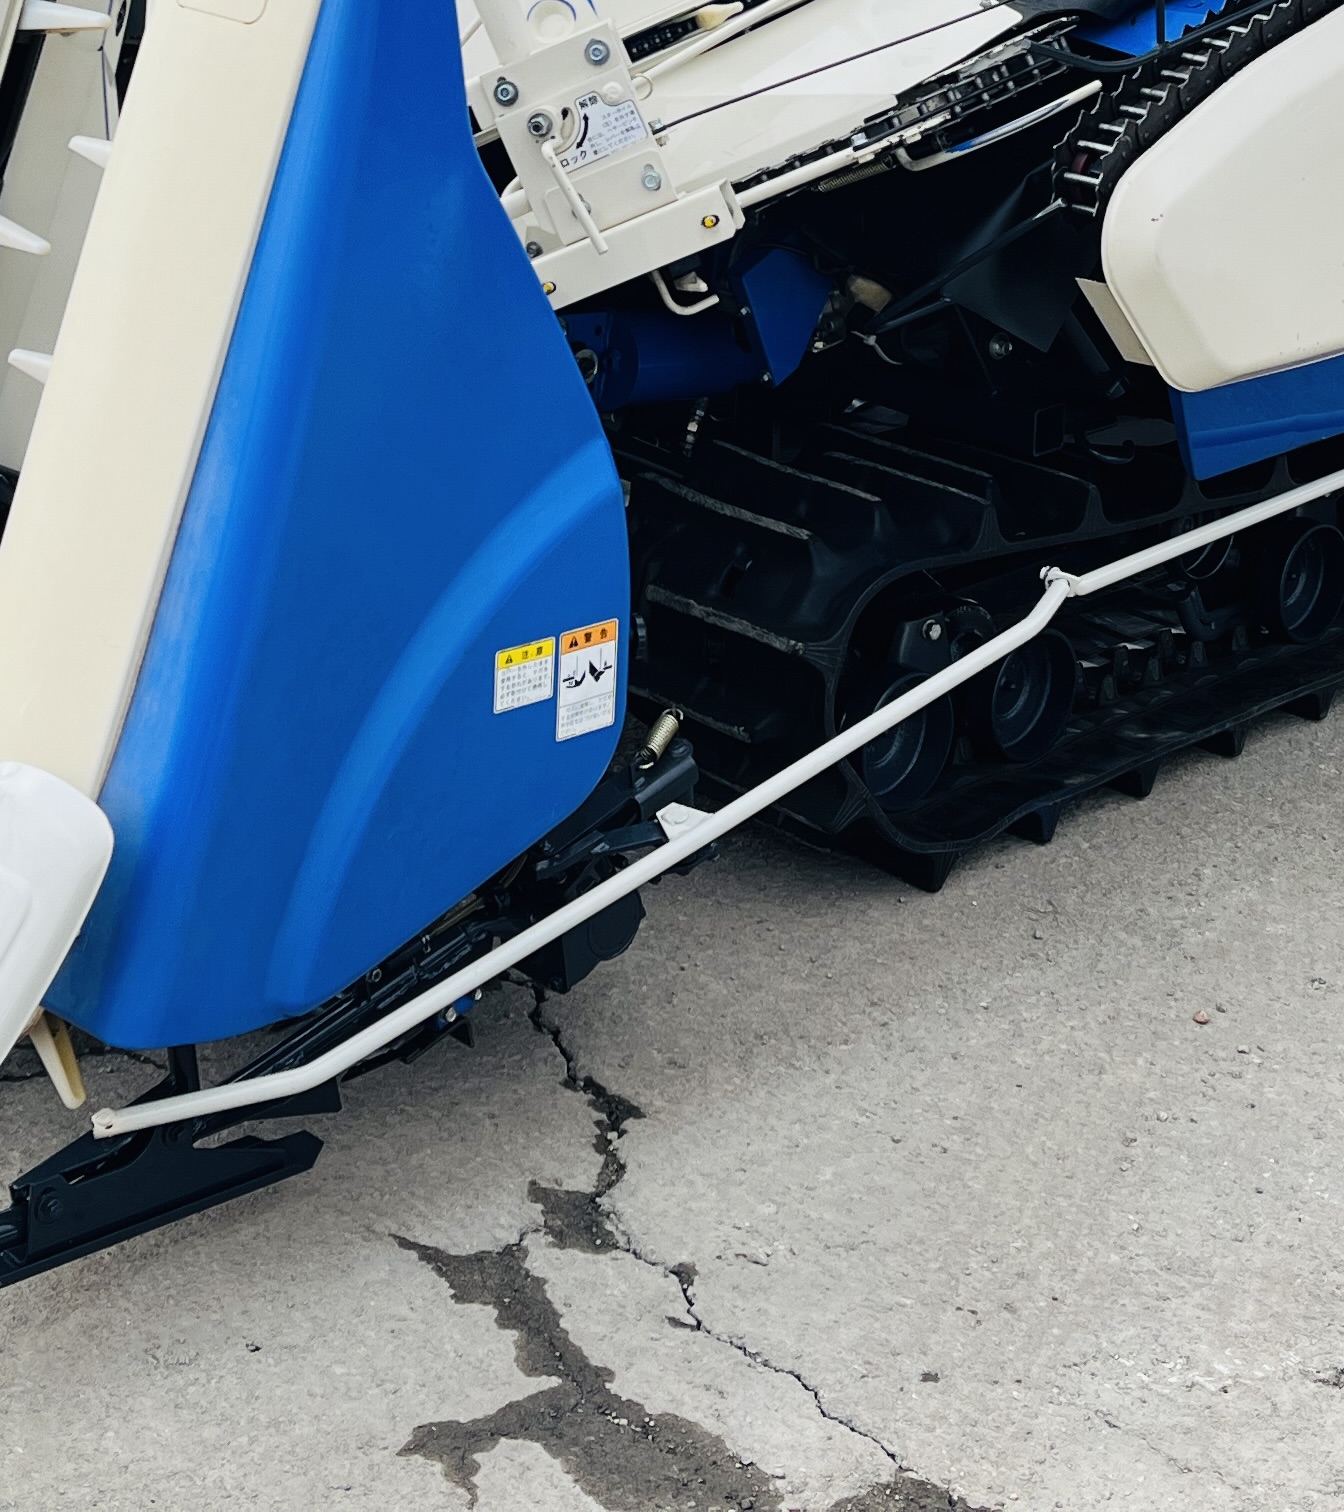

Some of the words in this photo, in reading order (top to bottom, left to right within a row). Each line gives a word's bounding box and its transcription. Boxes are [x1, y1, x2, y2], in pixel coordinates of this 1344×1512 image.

[560, 150, 587, 169] ロック
[584, 628, 608, 643] 警告
